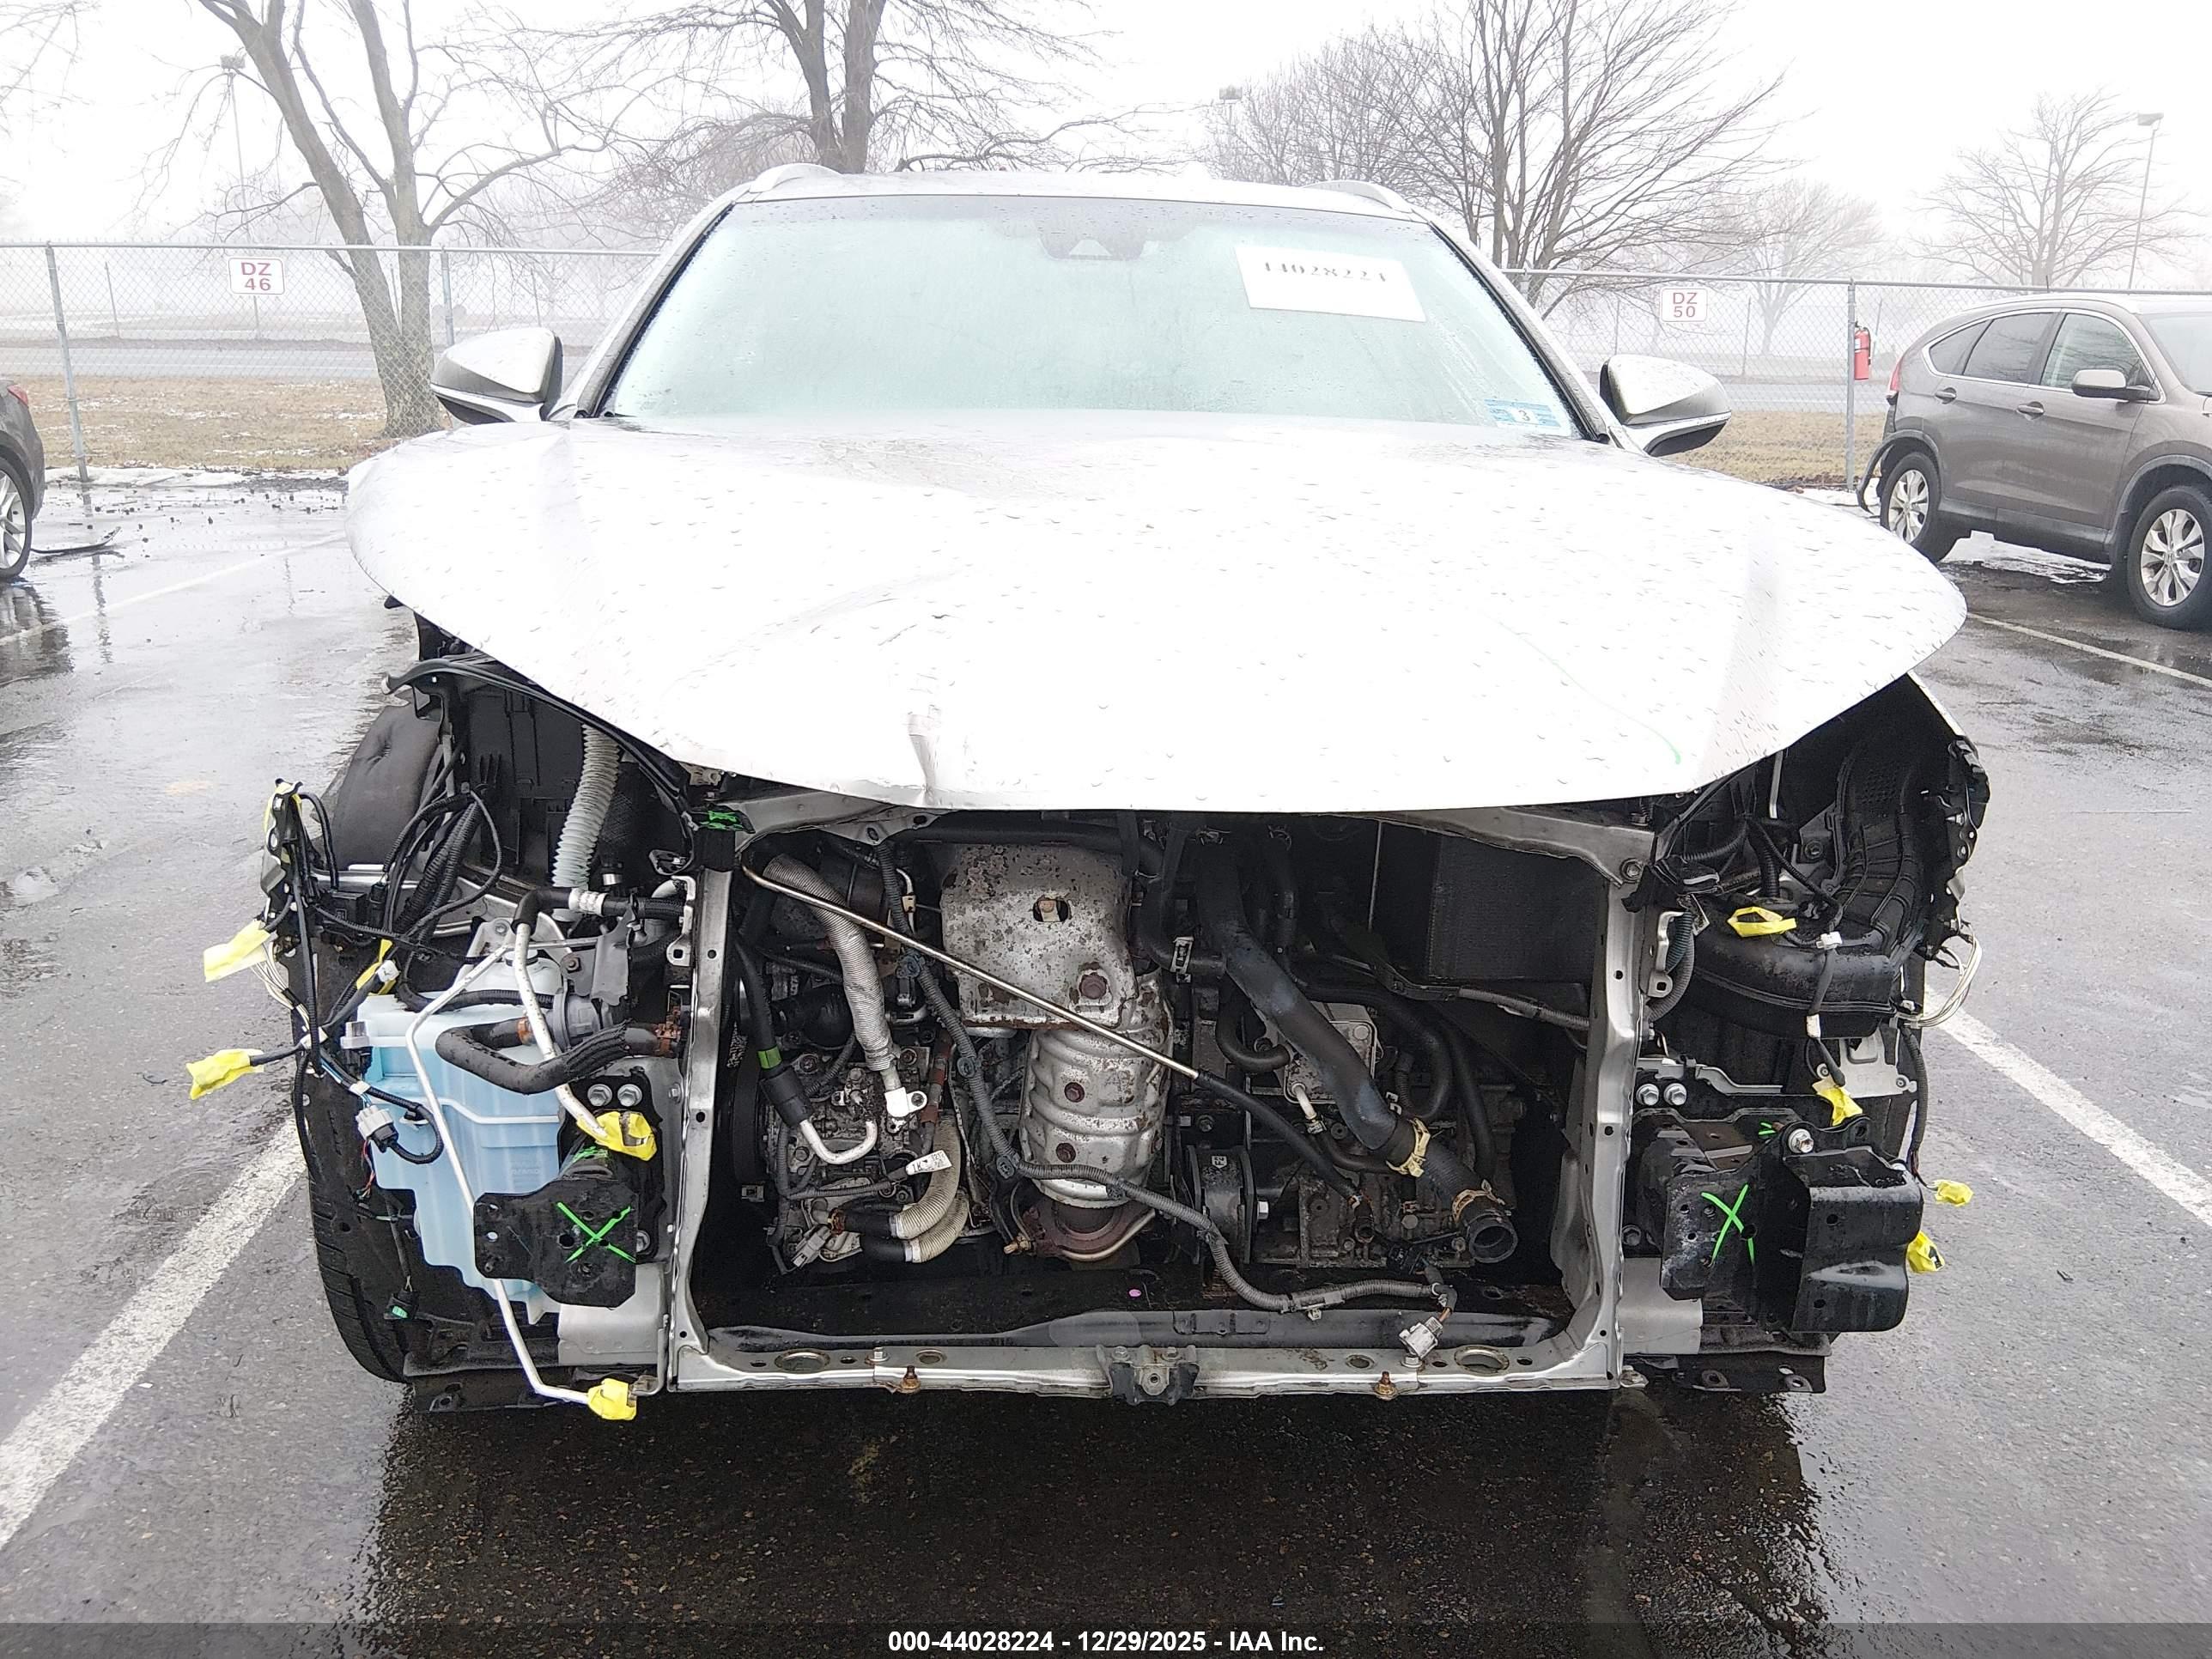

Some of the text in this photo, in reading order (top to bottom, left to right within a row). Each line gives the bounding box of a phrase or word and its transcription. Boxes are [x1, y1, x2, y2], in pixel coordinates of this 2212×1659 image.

[240, 262, 272, 276] DZ
[244, 277, 271, 291] 46
[1673, 292, 1698, 305] DZ
[1674, 306, 1696, 318] 50
[1518, 410, 1531, 422] 3
